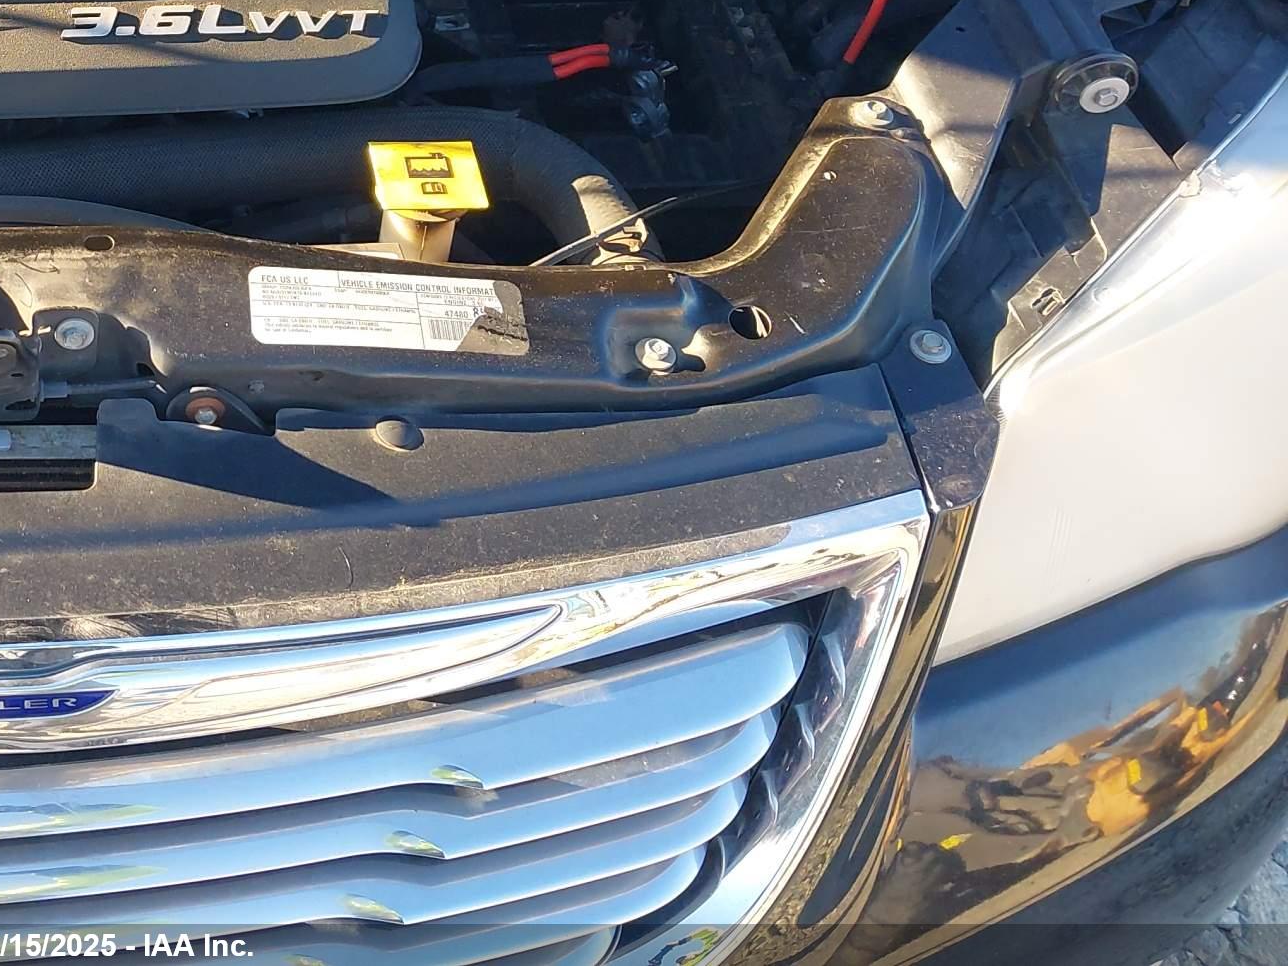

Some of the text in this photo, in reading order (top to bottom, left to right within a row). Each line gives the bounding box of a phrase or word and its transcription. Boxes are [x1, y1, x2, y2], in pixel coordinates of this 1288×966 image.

[261, 274, 309, 285] FCA US LLC
[341, 279, 374, 289] VEHICLE
[375, 281, 414, 292] EMISSION
[415, 283, 451, 294] CONTROL
